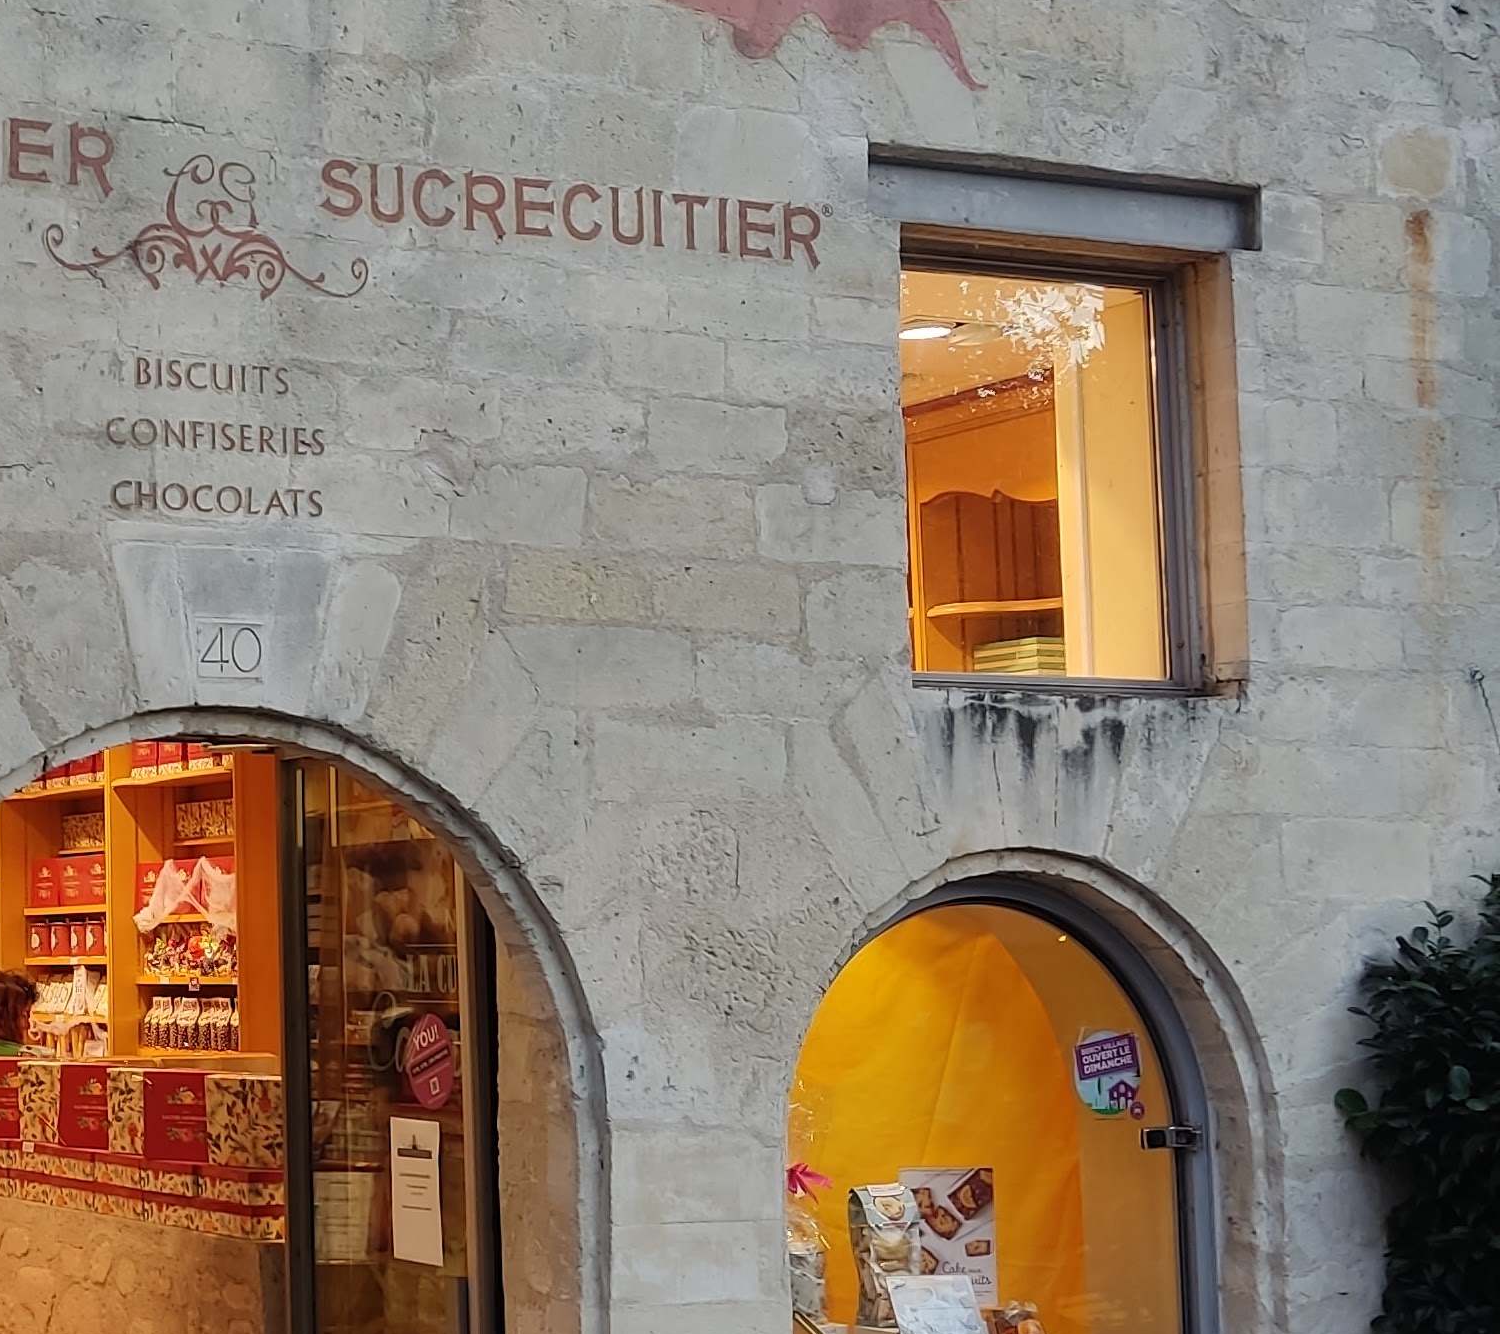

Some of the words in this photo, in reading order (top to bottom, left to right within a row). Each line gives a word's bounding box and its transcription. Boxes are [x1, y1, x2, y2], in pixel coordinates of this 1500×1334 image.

[134, 356, 290, 395] BISCUITS
[105, 417, 326, 455] CONFISERIES
[109, 480, 324, 517] CHOCOLATS
[200, 626, 262, 673] 40
[413, 1024, 439, 1052] YOU!
[1082, 1049, 1118, 1065] OUVERT
[1119, 1045, 1132, 1055] LE
[1083, 1055, 1133, 1075] DIMANCHE
[942, 1261, 966, 1275] Cake
